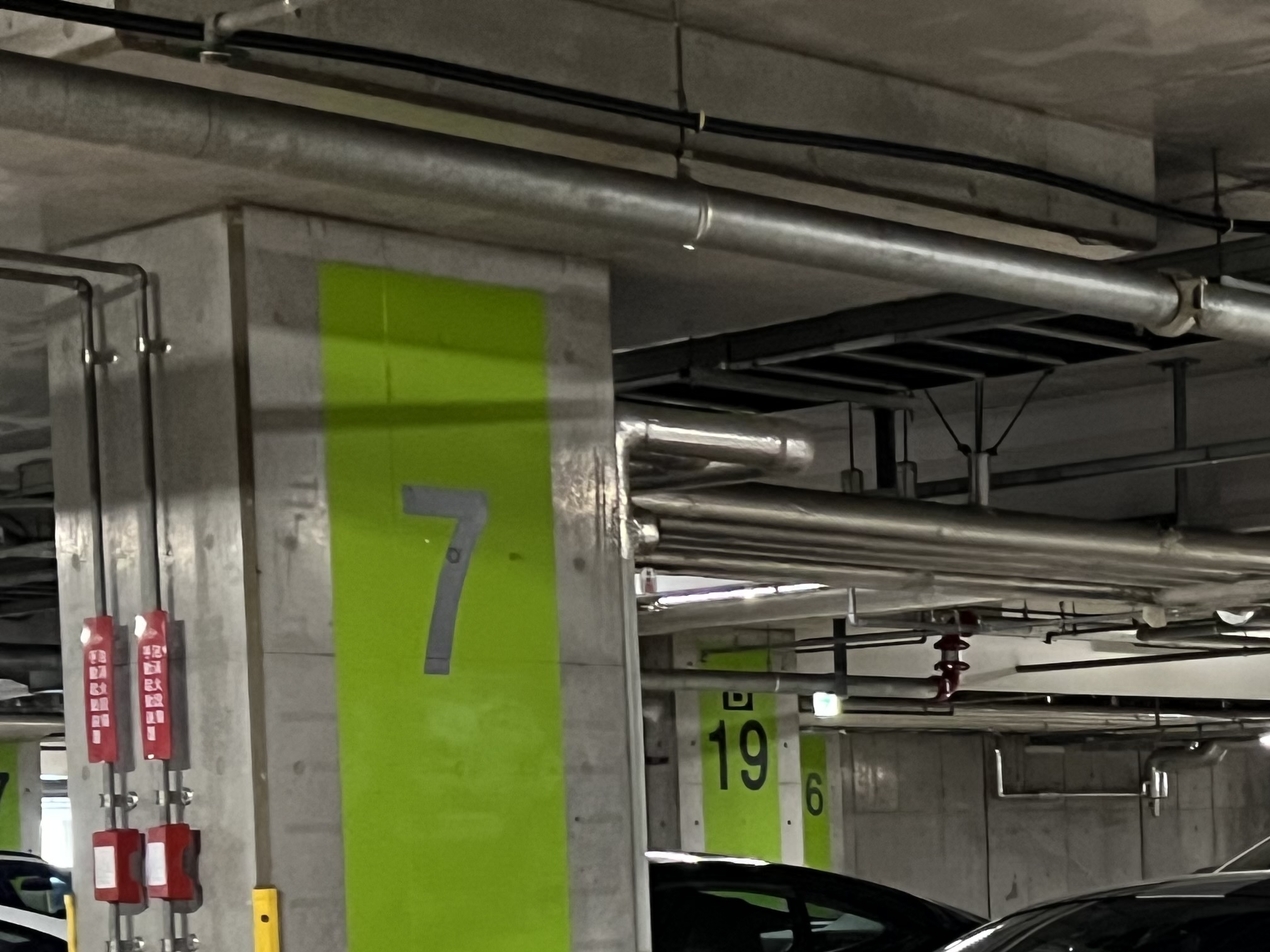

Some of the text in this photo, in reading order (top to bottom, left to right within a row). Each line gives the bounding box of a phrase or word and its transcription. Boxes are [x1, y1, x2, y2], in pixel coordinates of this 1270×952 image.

[402, 484, 488, 675] 7
[709, 719, 768, 791] 19
[805, 772, 824, 816] 6
